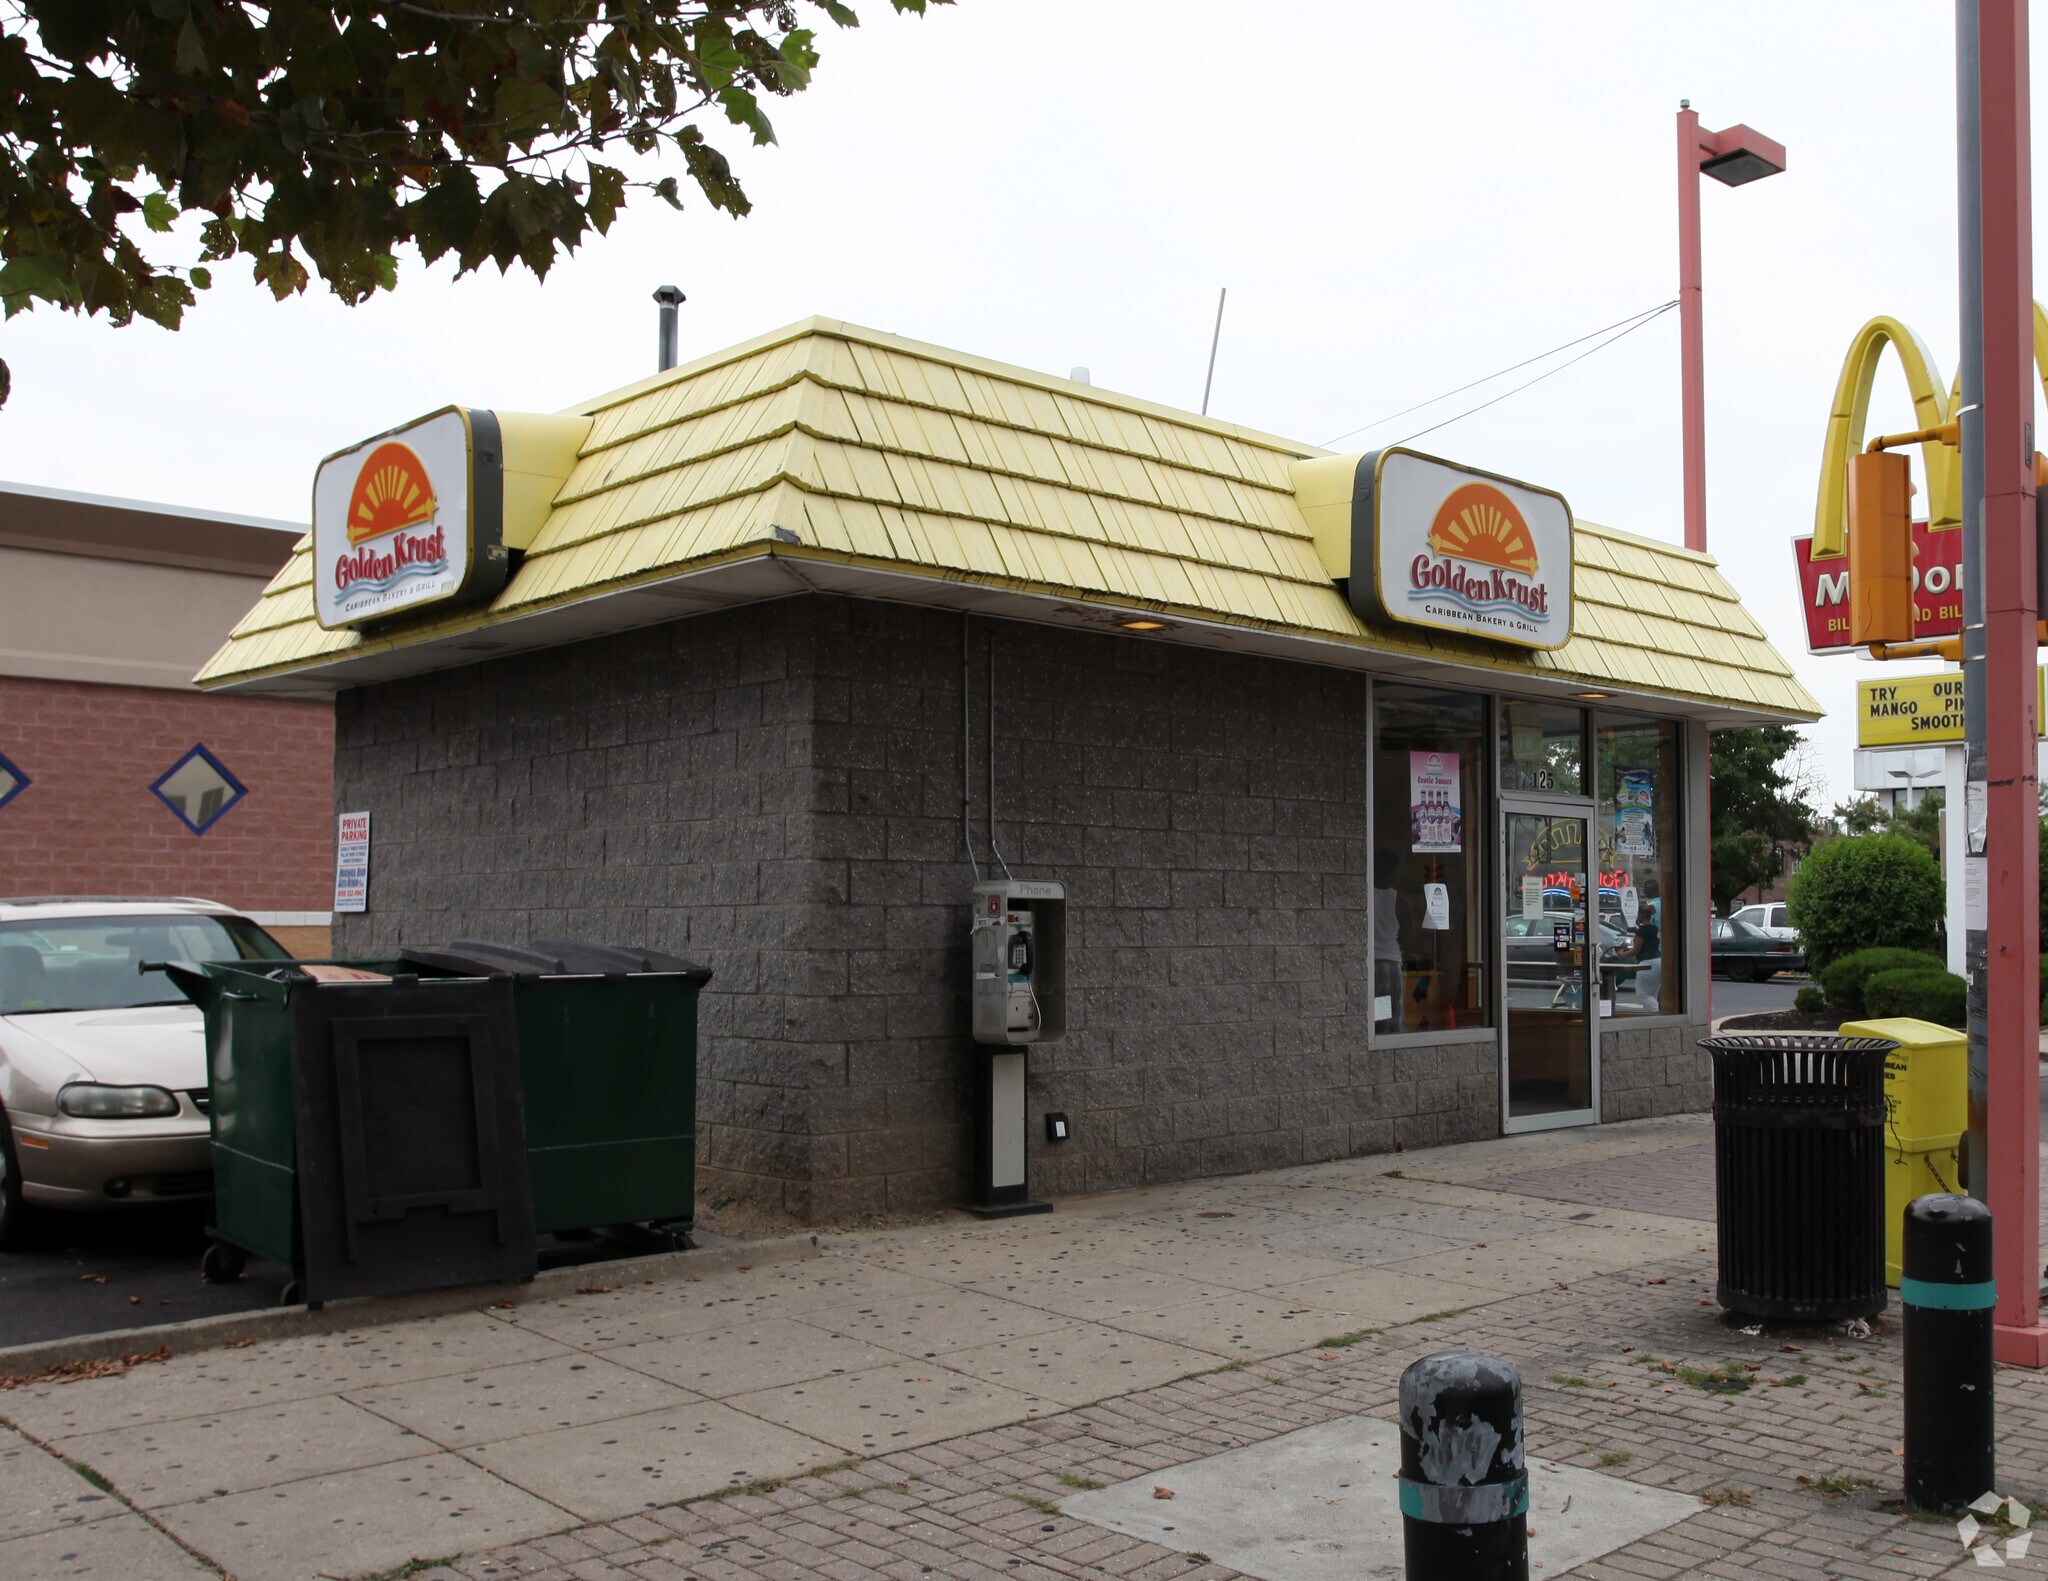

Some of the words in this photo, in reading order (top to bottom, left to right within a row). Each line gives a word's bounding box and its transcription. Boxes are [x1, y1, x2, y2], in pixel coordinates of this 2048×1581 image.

[345, 596, 381, 613] CARIBBEAN
[383, 589, 408, 602] BAKERY
[415, 581, 436, 593] GRILL
[1425, 605, 1473, 621] CARIBBEAN
[1475, 613, 1507, 627] BAKERY
[1516, 621, 1538, 633] GRILL
[1870, 687, 1897, 701] TRY
[1933, 682, 1963, 697] OUR
[1870, 701, 1918, 717] MANGO
[1417, 775, 1434, 785] Exotic
[1531, 769, 1554, 790] 125
[343, 818, 366, 829] PRIVATE
[342, 830, 366, 842] PARKING
[1020, 884, 1052, 895] Phone
